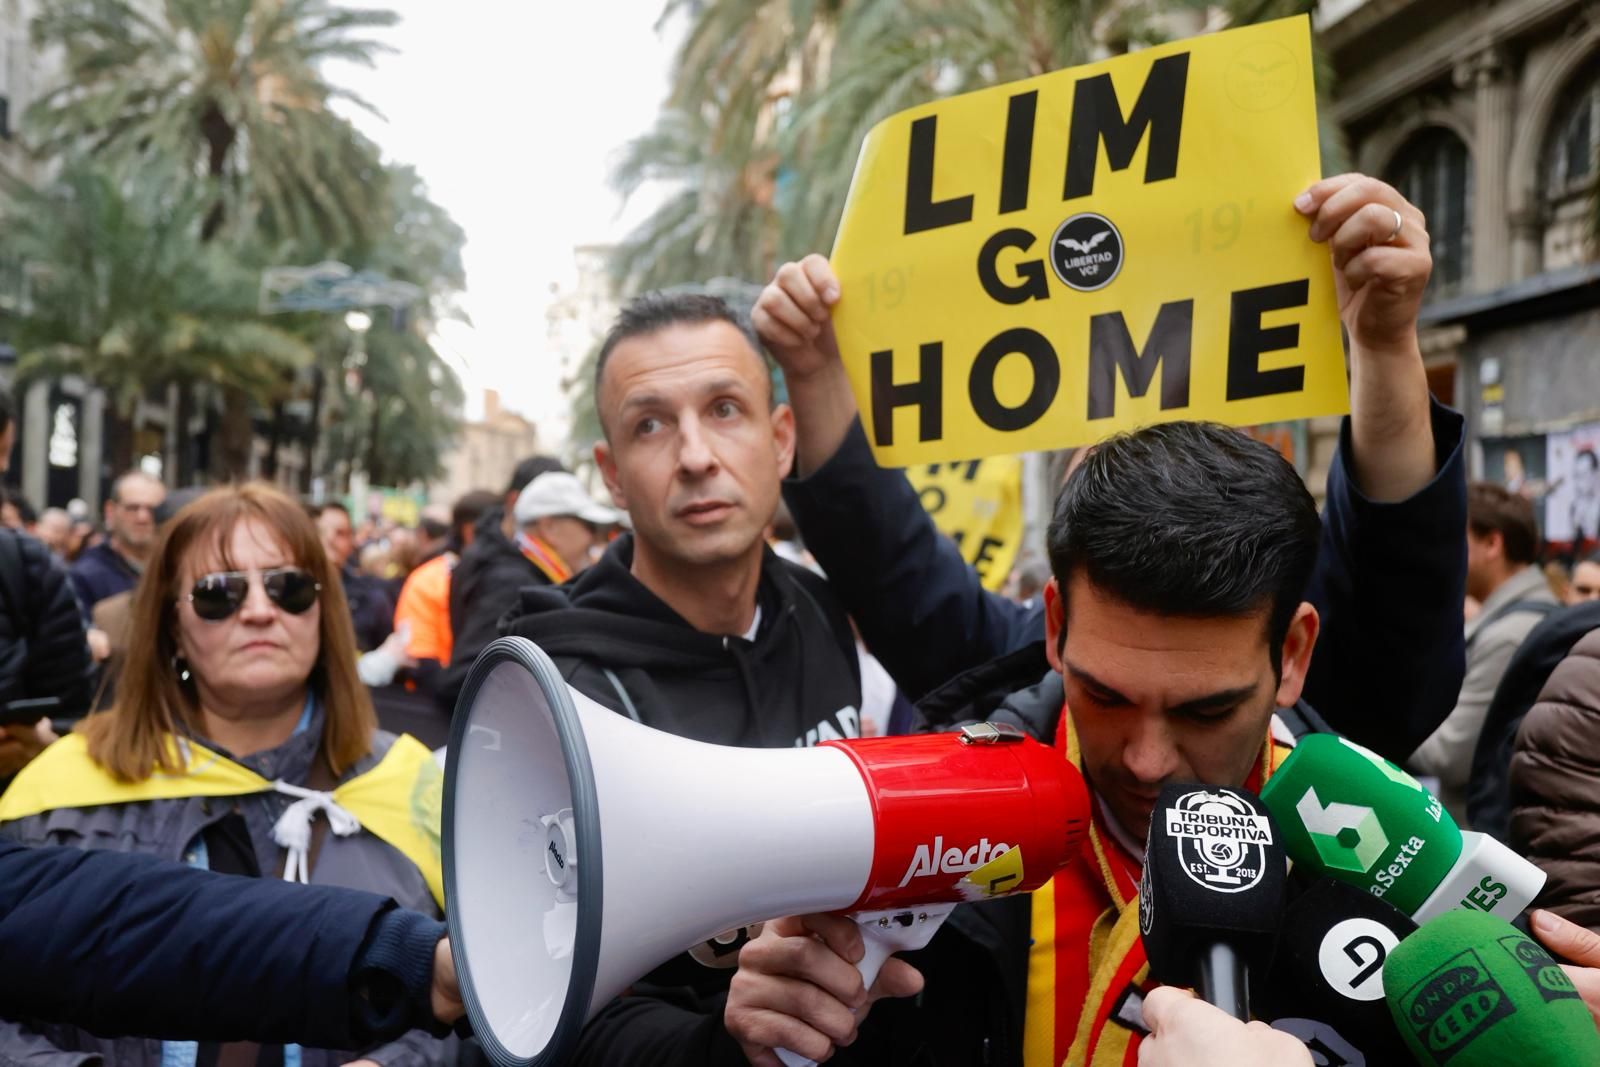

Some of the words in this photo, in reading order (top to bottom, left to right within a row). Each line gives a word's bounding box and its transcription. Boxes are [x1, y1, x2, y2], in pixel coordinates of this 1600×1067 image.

[903, 51, 1191, 236] LIM
[1064, 251, 1113, 269] LIBERTAD
[1079, 265, 1099, 277] VCF
[870, 278, 1310, 447] HOME
[1171, 822, 1270, 842] DEPORTIVA
[1180, 811, 1257, 829] TRIBUNA
[898, 835, 1011, 888] Alecto
[1190, 862, 1211, 875] EST.
[1235, 867, 1257, 879] 2013
[1370, 835, 1426, 897] aSexta
[1413, 971, 1473, 1017] ONDA
[1433, 994, 1491, 1043] CERO
